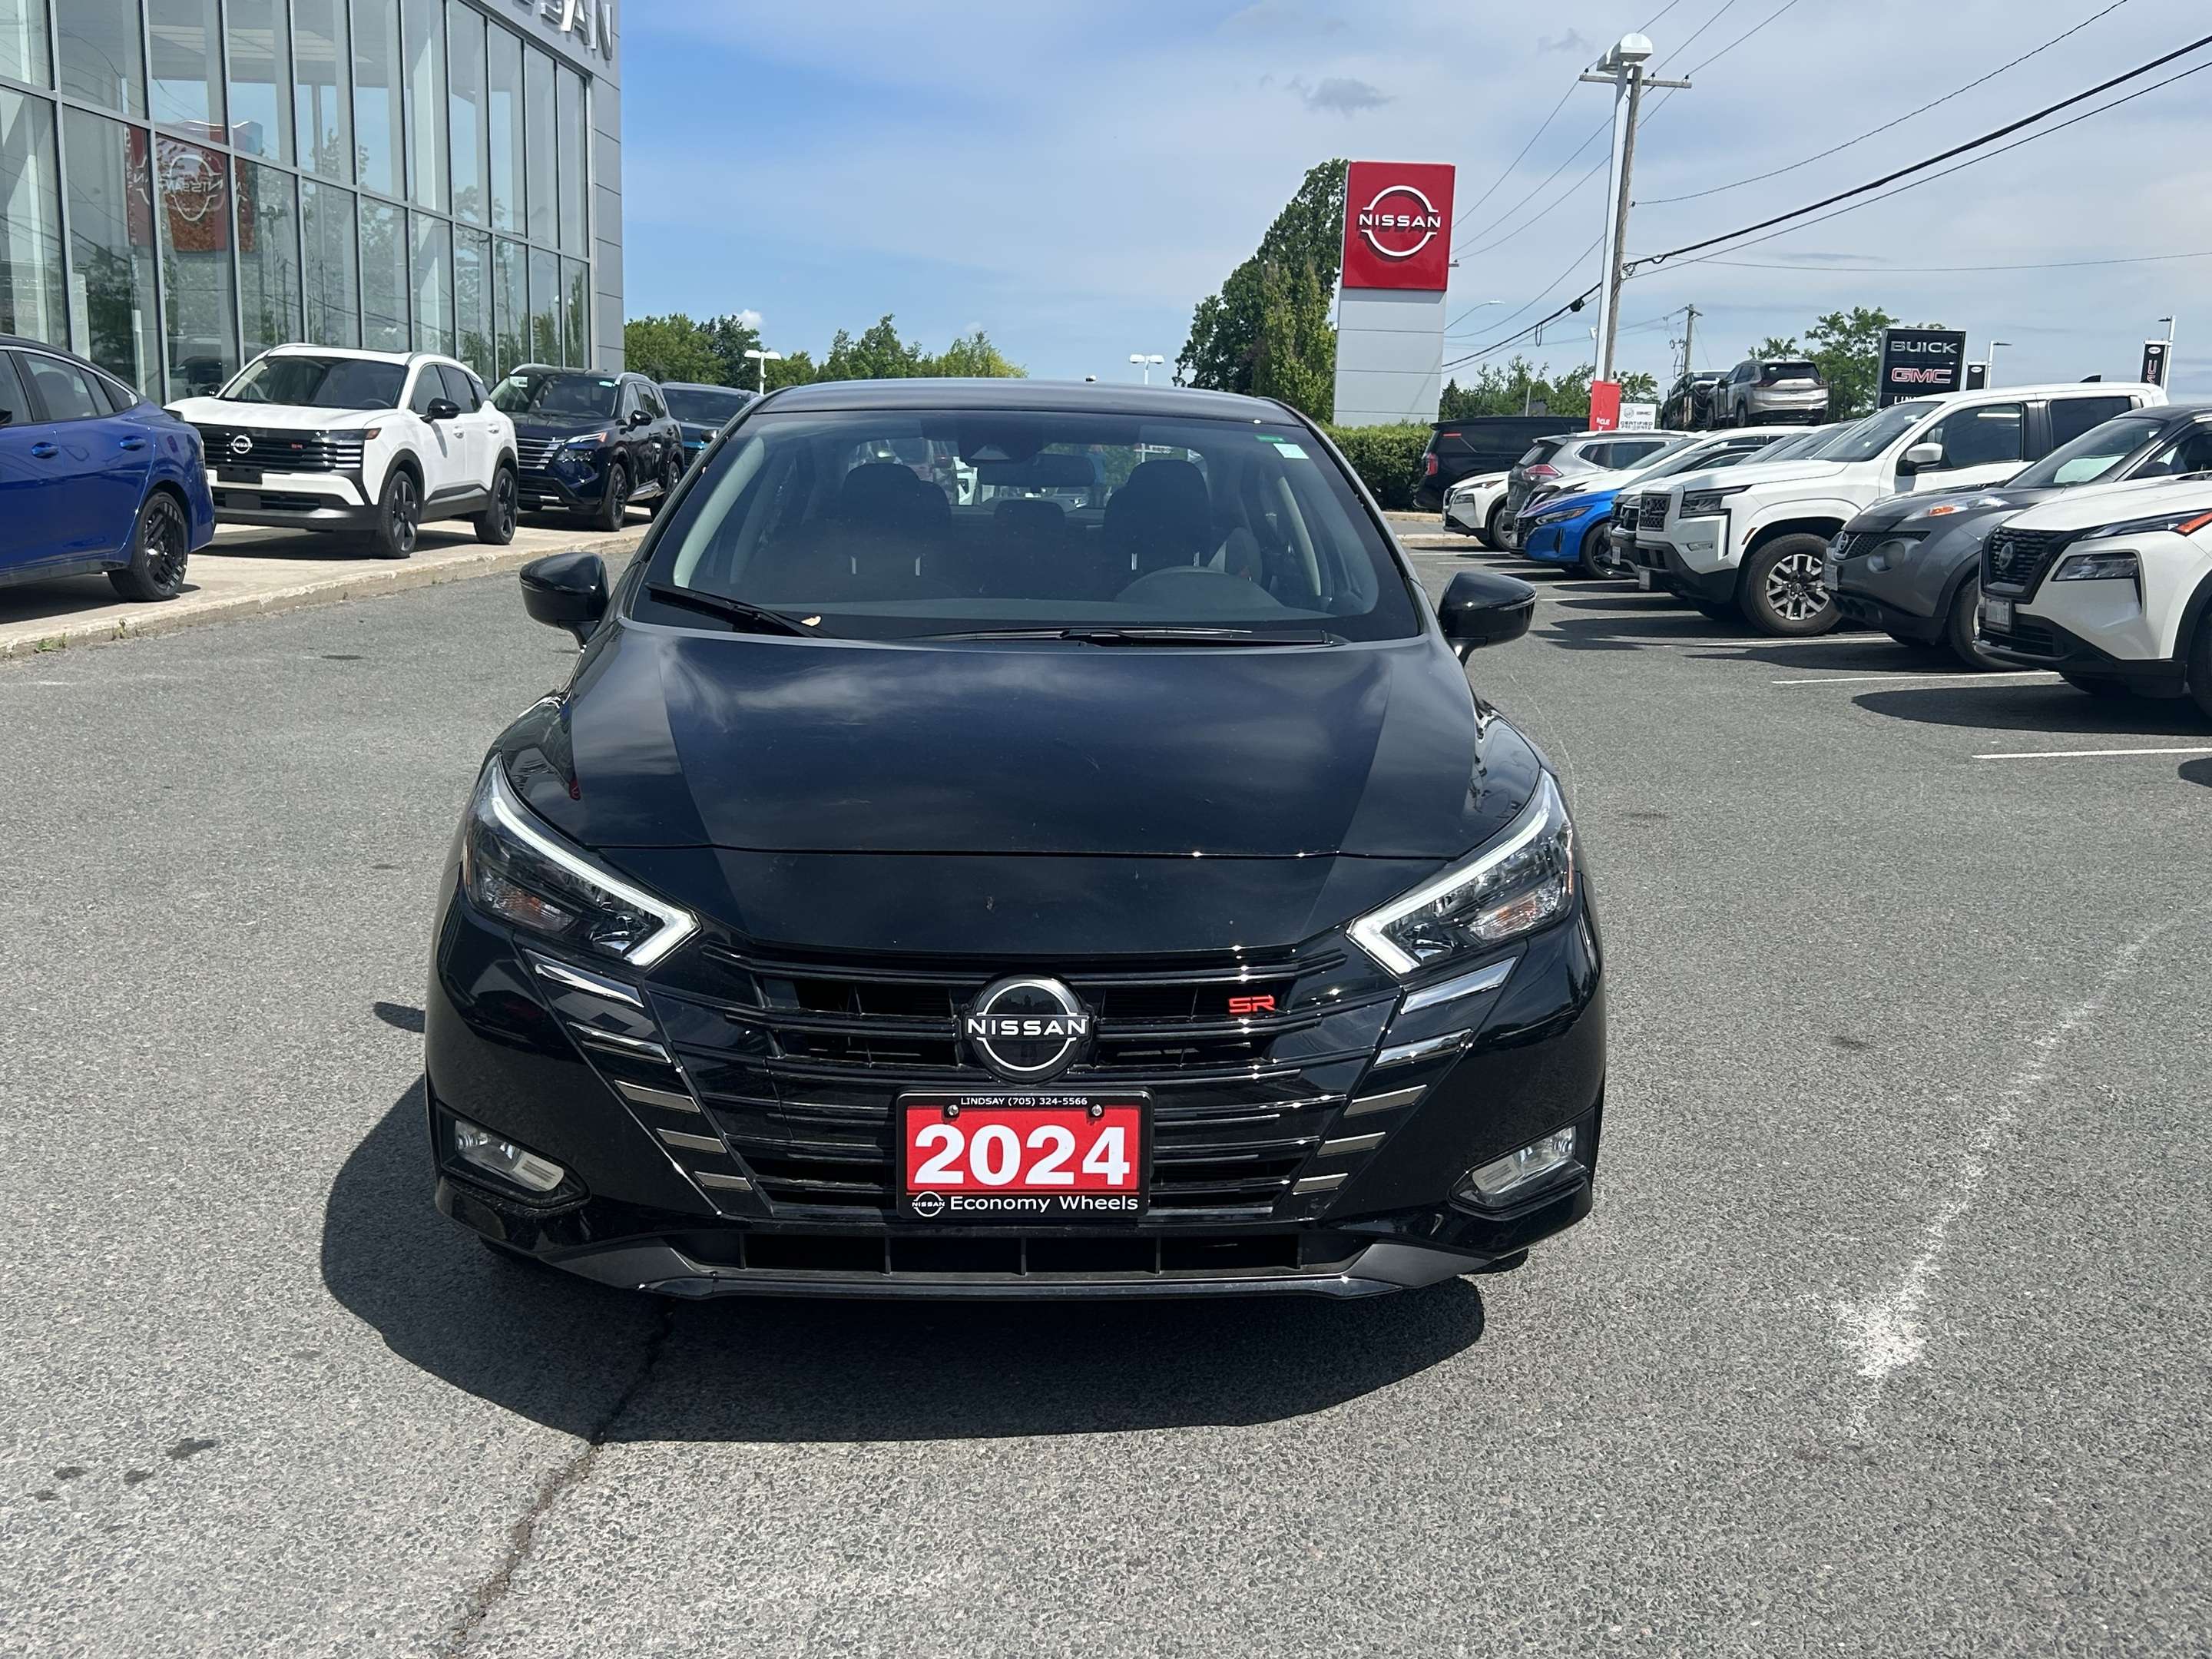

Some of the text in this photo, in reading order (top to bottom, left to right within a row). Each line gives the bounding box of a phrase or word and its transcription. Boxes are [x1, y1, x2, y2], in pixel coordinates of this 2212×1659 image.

[1359, 214, 1441, 228] NISSAN
[1890, 340, 1958, 354] BUICK
[1891, 367, 1952, 384] GMC
[1229, 995, 1275, 1013] SR
[967, 1018, 1088, 1036] NISSAN
[960, 1097, 1088, 1106] LINDSAY (705) 324-5566
[913, 1123, 1131, 1187] 2024
[950, 1195, 1051, 1213] Economy
[1059, 1195, 1139, 1211] Wheels
